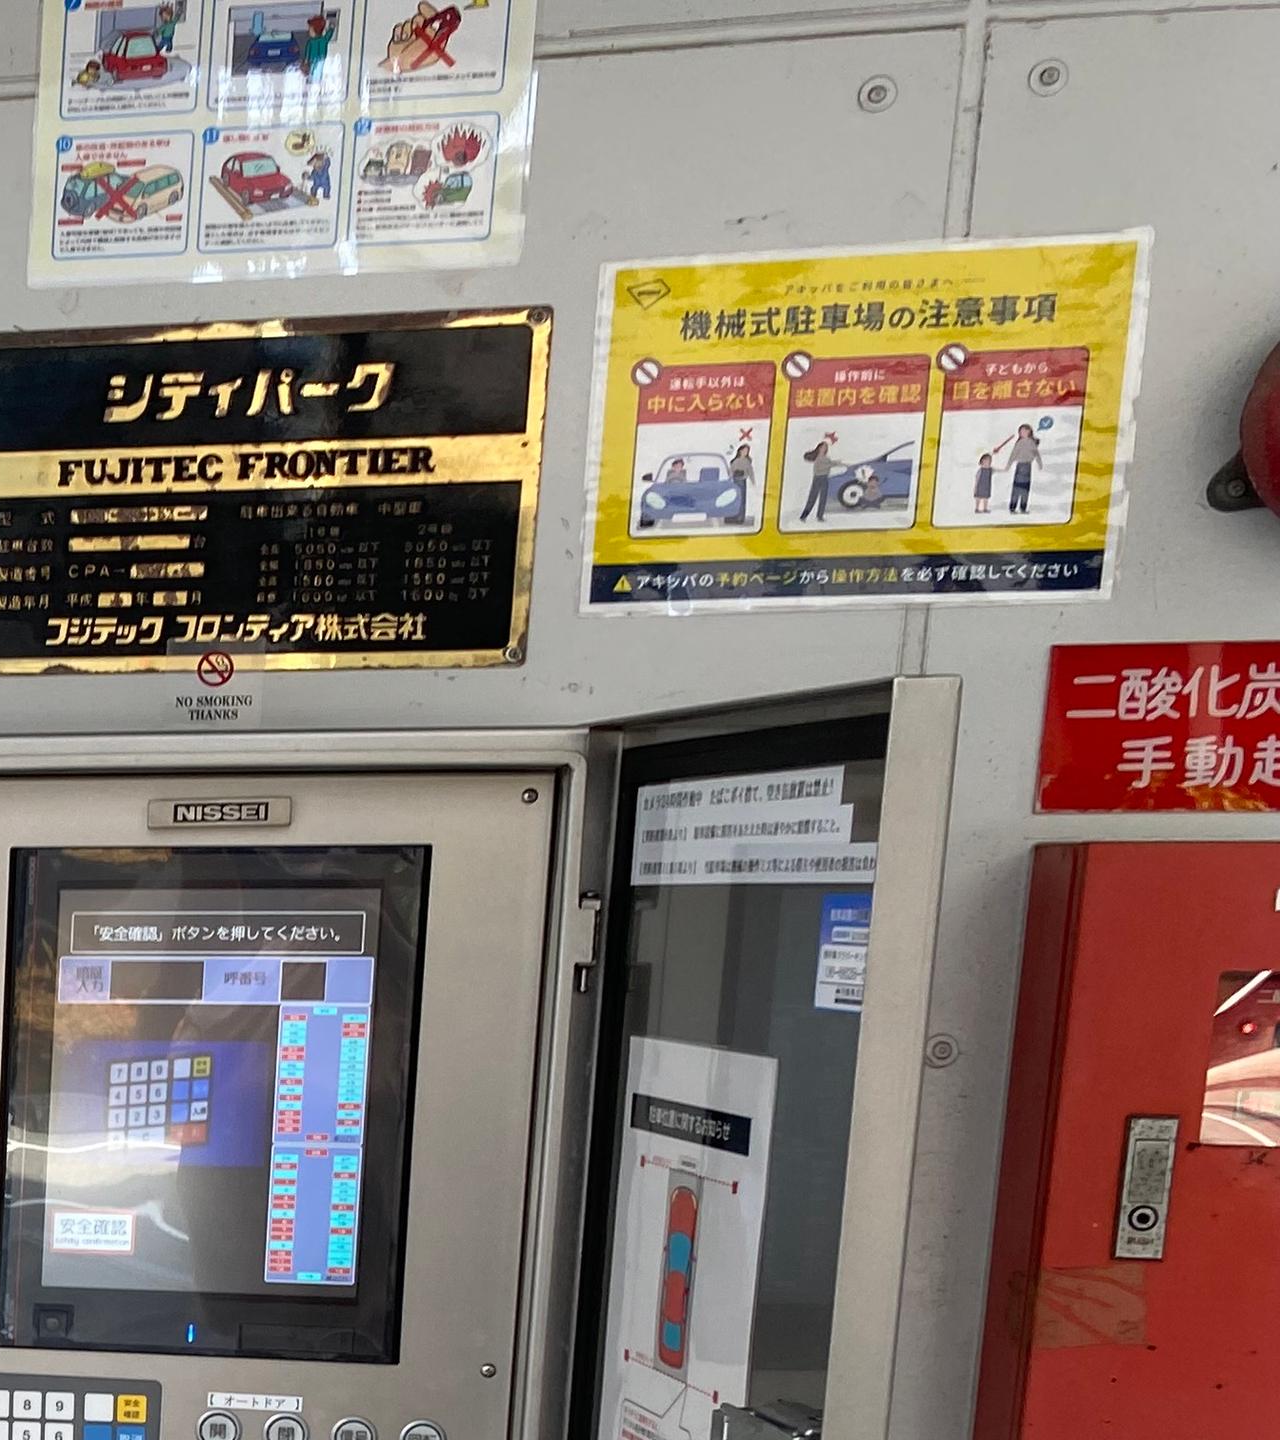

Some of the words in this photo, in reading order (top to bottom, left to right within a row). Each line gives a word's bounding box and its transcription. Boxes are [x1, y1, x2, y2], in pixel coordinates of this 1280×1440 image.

[357, 119, 371, 133] 12
[206, 129, 218, 143] 11
[59, 139, 71, 150] 10
[678, 292, 1059, 341] 機械式駐車場の注意事項
[834, 368, 886, 383] 操作前に
[985, 361, 1049, 376] 子どもから
[669, 374, 745, 391] 運転手以外は
[952, 377, 1078, 401] 目を離さない
[104, 361, 396, 424] シティパーク
[794, 383, 923, 409] 装置内を確認
[646, 393, 765, 414] 中に入らない
[58, 453, 224, 488] FUJITEC
[237, 446, 436, 483] FRONTIER
[190, 590, 203, 605] 月
[45, 614, 165, 647] フジテック
[174, 611, 429, 644] フロンティア株式会社
[1066, 661, 1280, 721] 二酸化炭
[174, 695, 194, 708] NO
[196, 694, 253, 708] SMOKING
[187, 707, 239, 721] THANKS
[175, 803, 268, 822] NISSEI
[77, 981, 104, 993] 入力
[60, 1217, 128, 1236] 安全確認
[23, 1399, 31, 1411] 8
[55, 1400, 64, 1412] 9
[22, 1429, 31, 1440] 5
